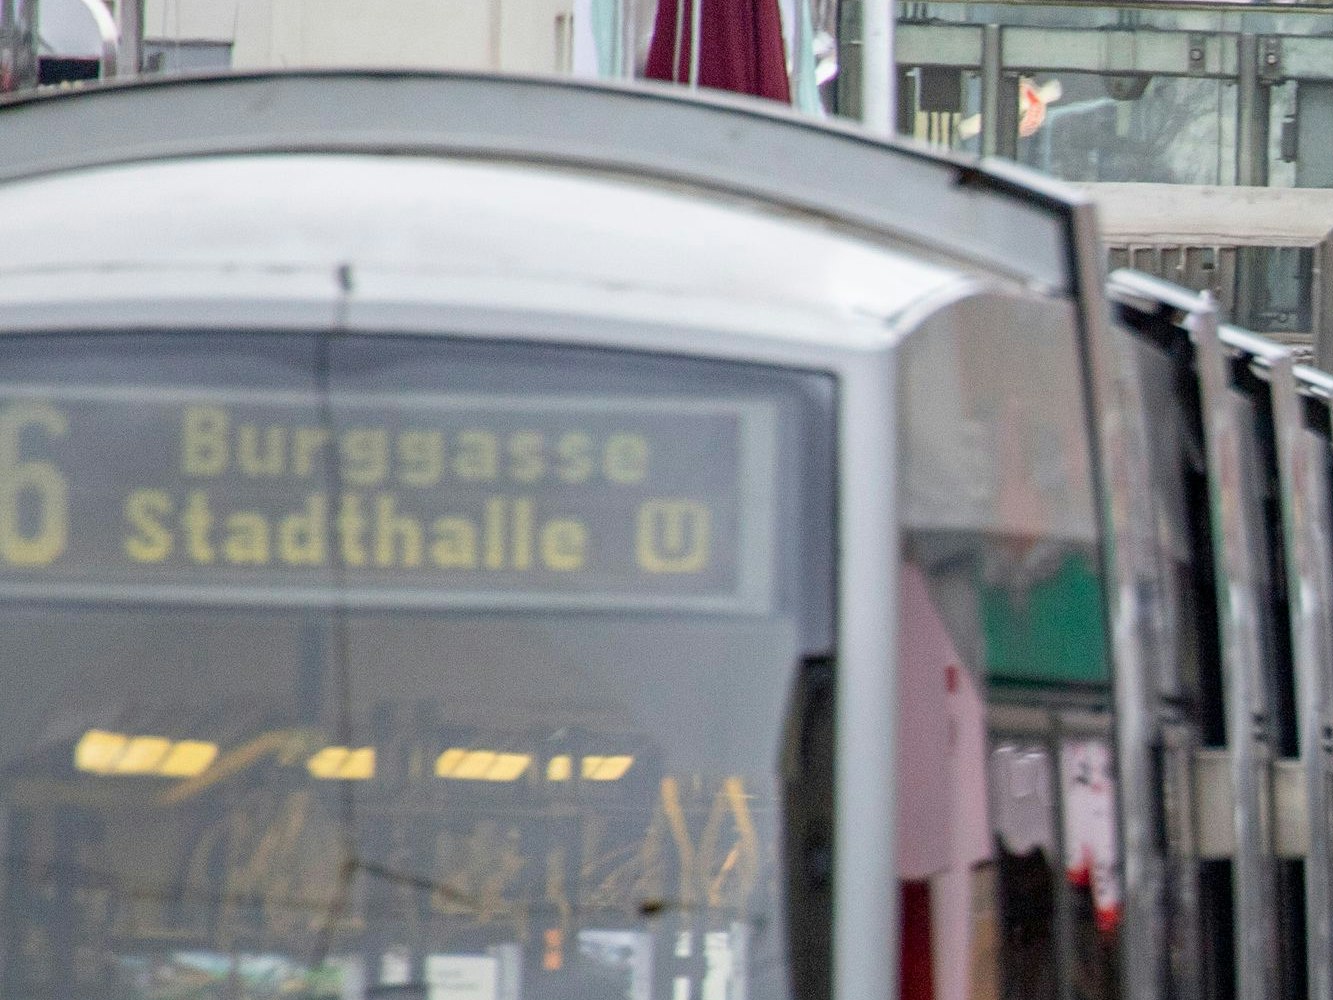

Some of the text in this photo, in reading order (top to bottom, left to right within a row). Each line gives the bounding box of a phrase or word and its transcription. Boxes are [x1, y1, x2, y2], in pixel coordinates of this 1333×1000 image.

[0, 400, 67, 566] 6
[182, 404, 652, 487] Burggasse
[124, 489, 590, 572] Stadthalle
